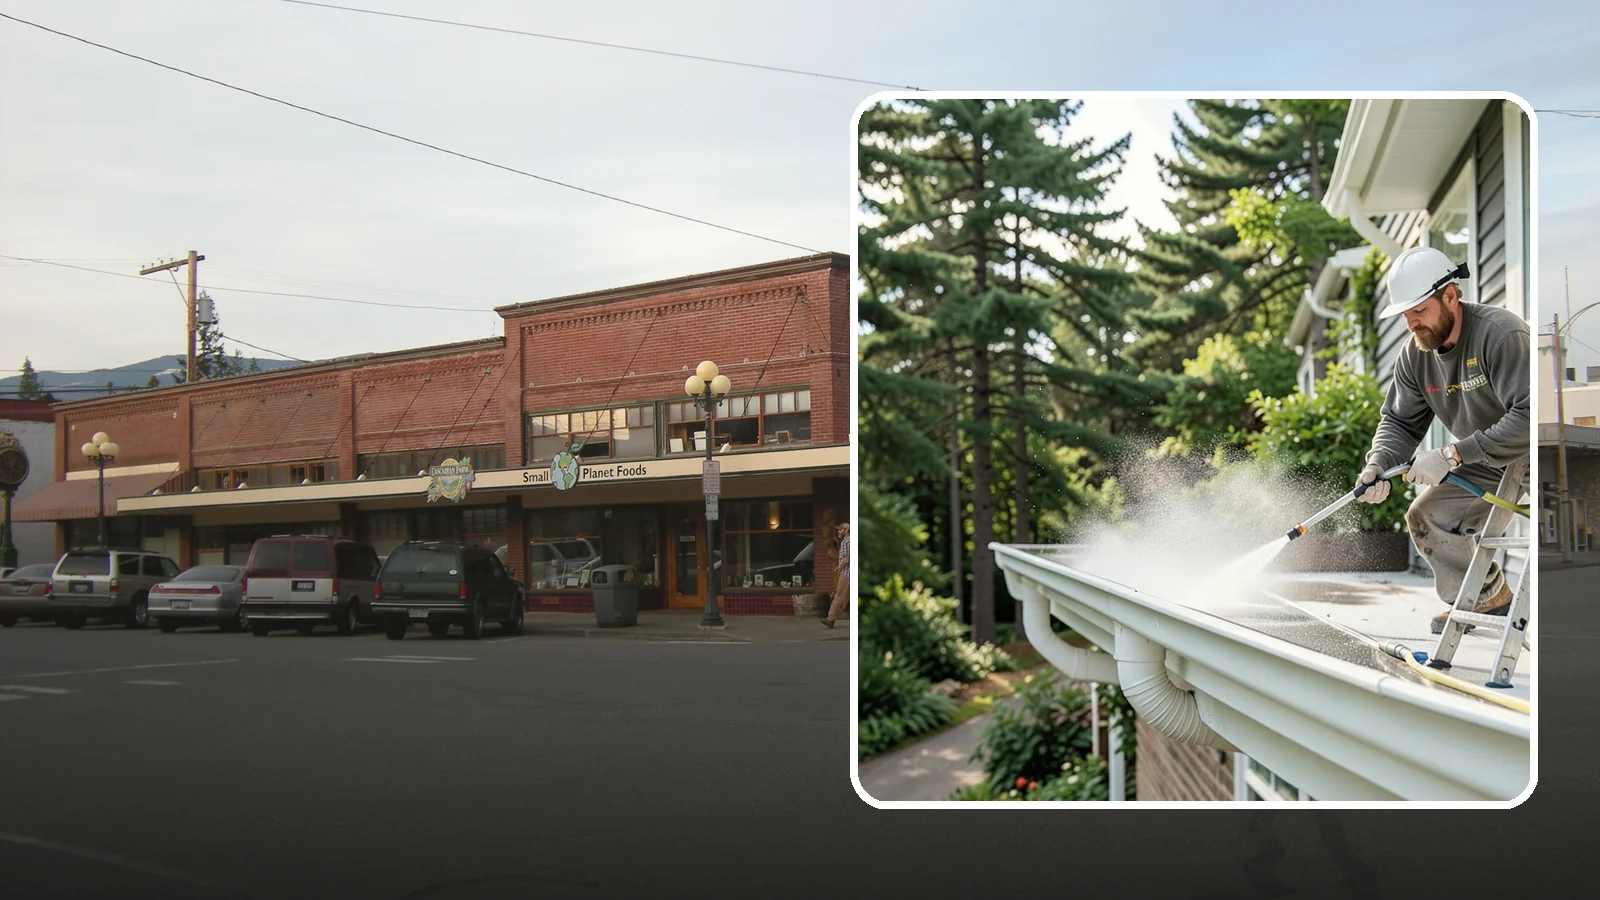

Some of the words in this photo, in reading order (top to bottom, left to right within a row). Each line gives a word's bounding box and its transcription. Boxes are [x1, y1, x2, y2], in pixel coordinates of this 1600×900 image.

[431, 466, 456, 476] CASCADIAN
[456, 465, 469, 474] FARM
[523, 470, 549, 483] Small
[582, 467, 614, 479] Planet
[617, 464, 647, 477] Foods
